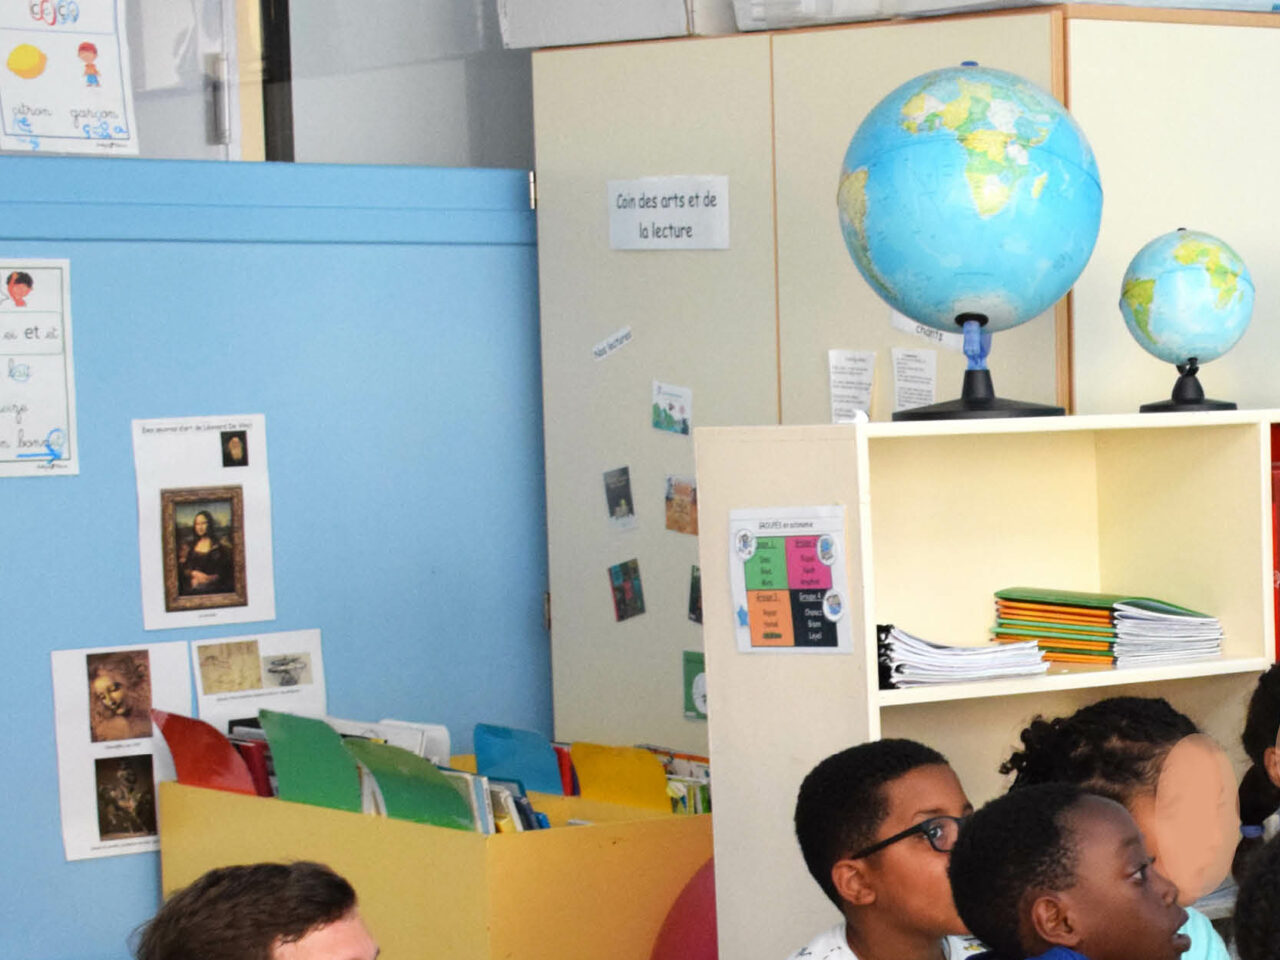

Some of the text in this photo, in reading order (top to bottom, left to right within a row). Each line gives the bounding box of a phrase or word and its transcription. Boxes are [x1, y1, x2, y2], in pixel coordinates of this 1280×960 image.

[616, 189, 717, 209] Coin des arts et de
[639, 221, 693, 239] la lecture
[24, 325, 40, 340] et
